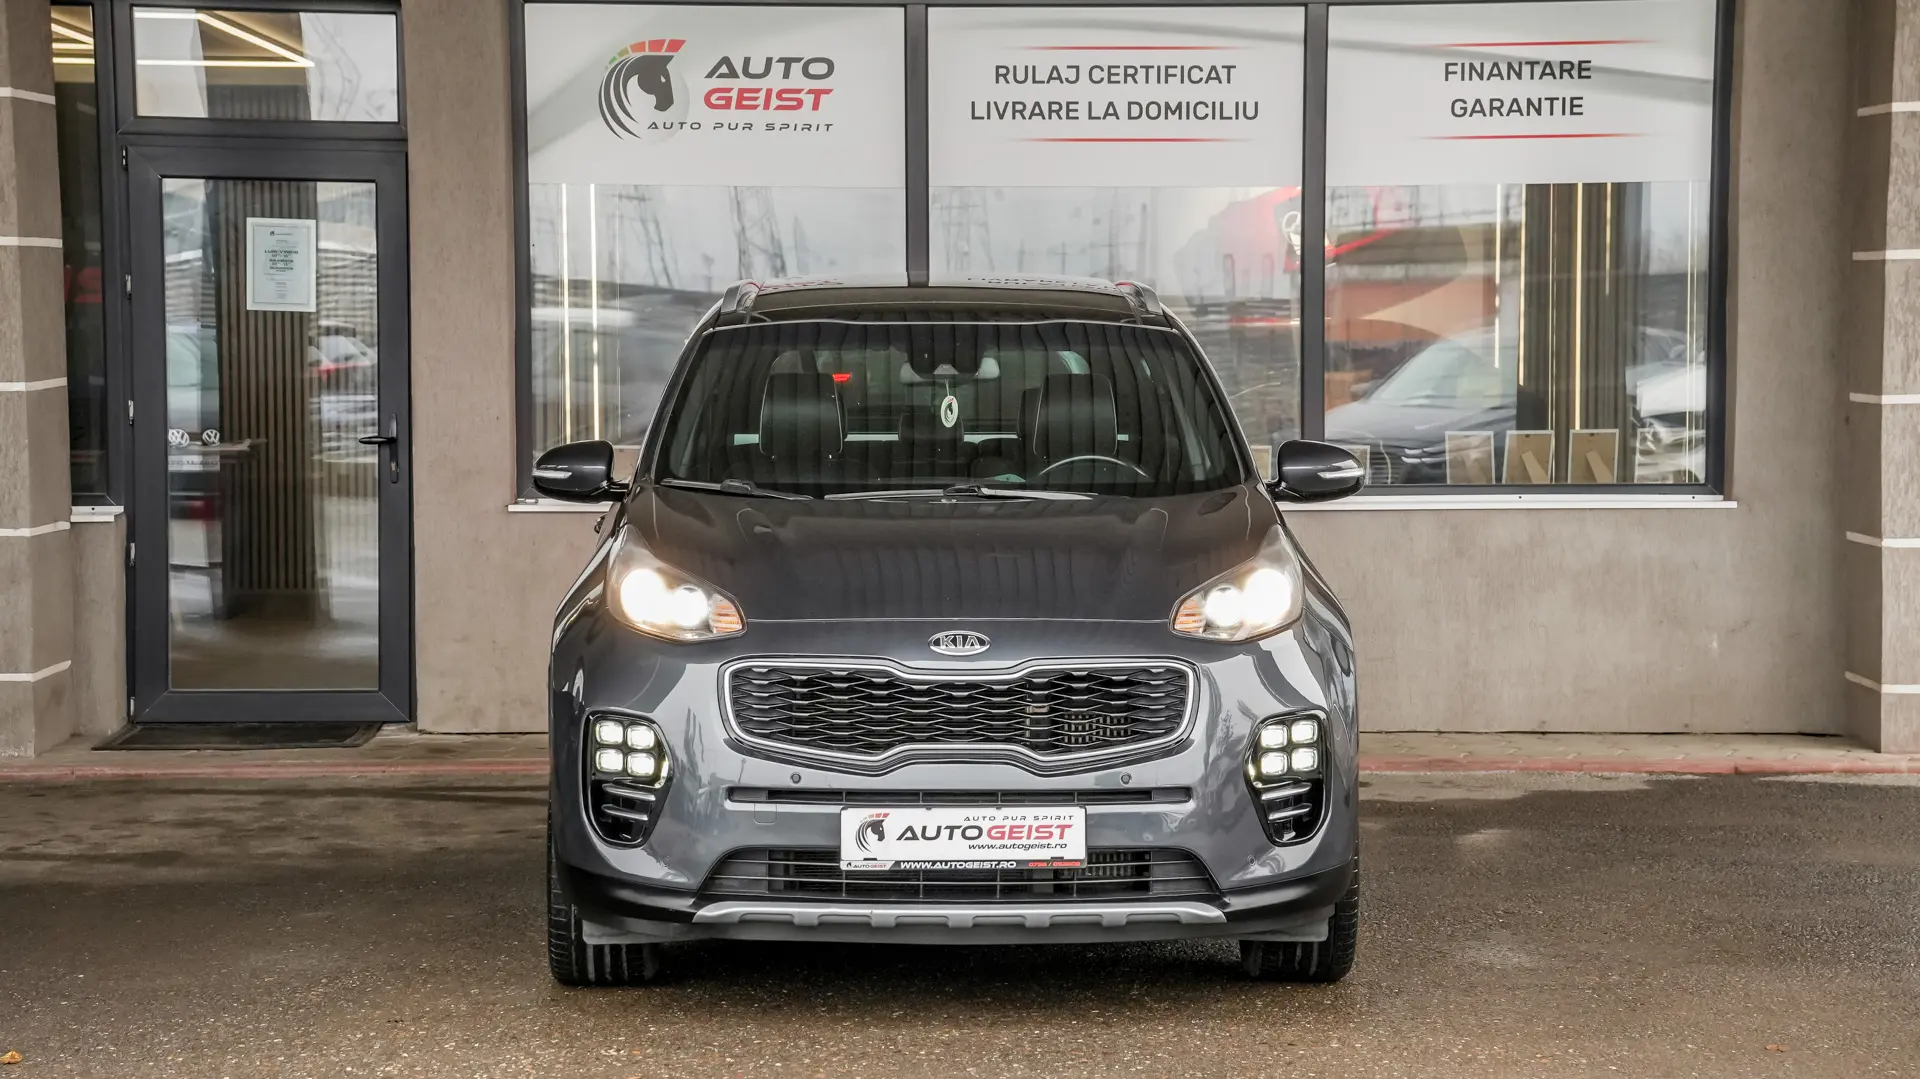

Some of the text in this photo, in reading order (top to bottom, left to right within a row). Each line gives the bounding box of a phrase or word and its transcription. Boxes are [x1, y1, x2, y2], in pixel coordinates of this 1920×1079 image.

[703, 55, 835, 80] AUTO
[994, 65, 1237, 85] RULAJ CERTIFICAT
[1444, 60, 1592, 82] FINANTARE
[703, 87, 834, 111] GEIST
[1450, 96, 1584, 118] GARANTIE
[971, 101, 1260, 121] LIVRARE LA DOMICILIU
[647, 121, 834, 132] AUTO PUR SPIRIT
[939, 635, 981, 649] KIA
[968, 842, 1068, 852] www.autogeist.ro
[900, 861, 1017, 869] WWW.AUTOGEIST.RO
